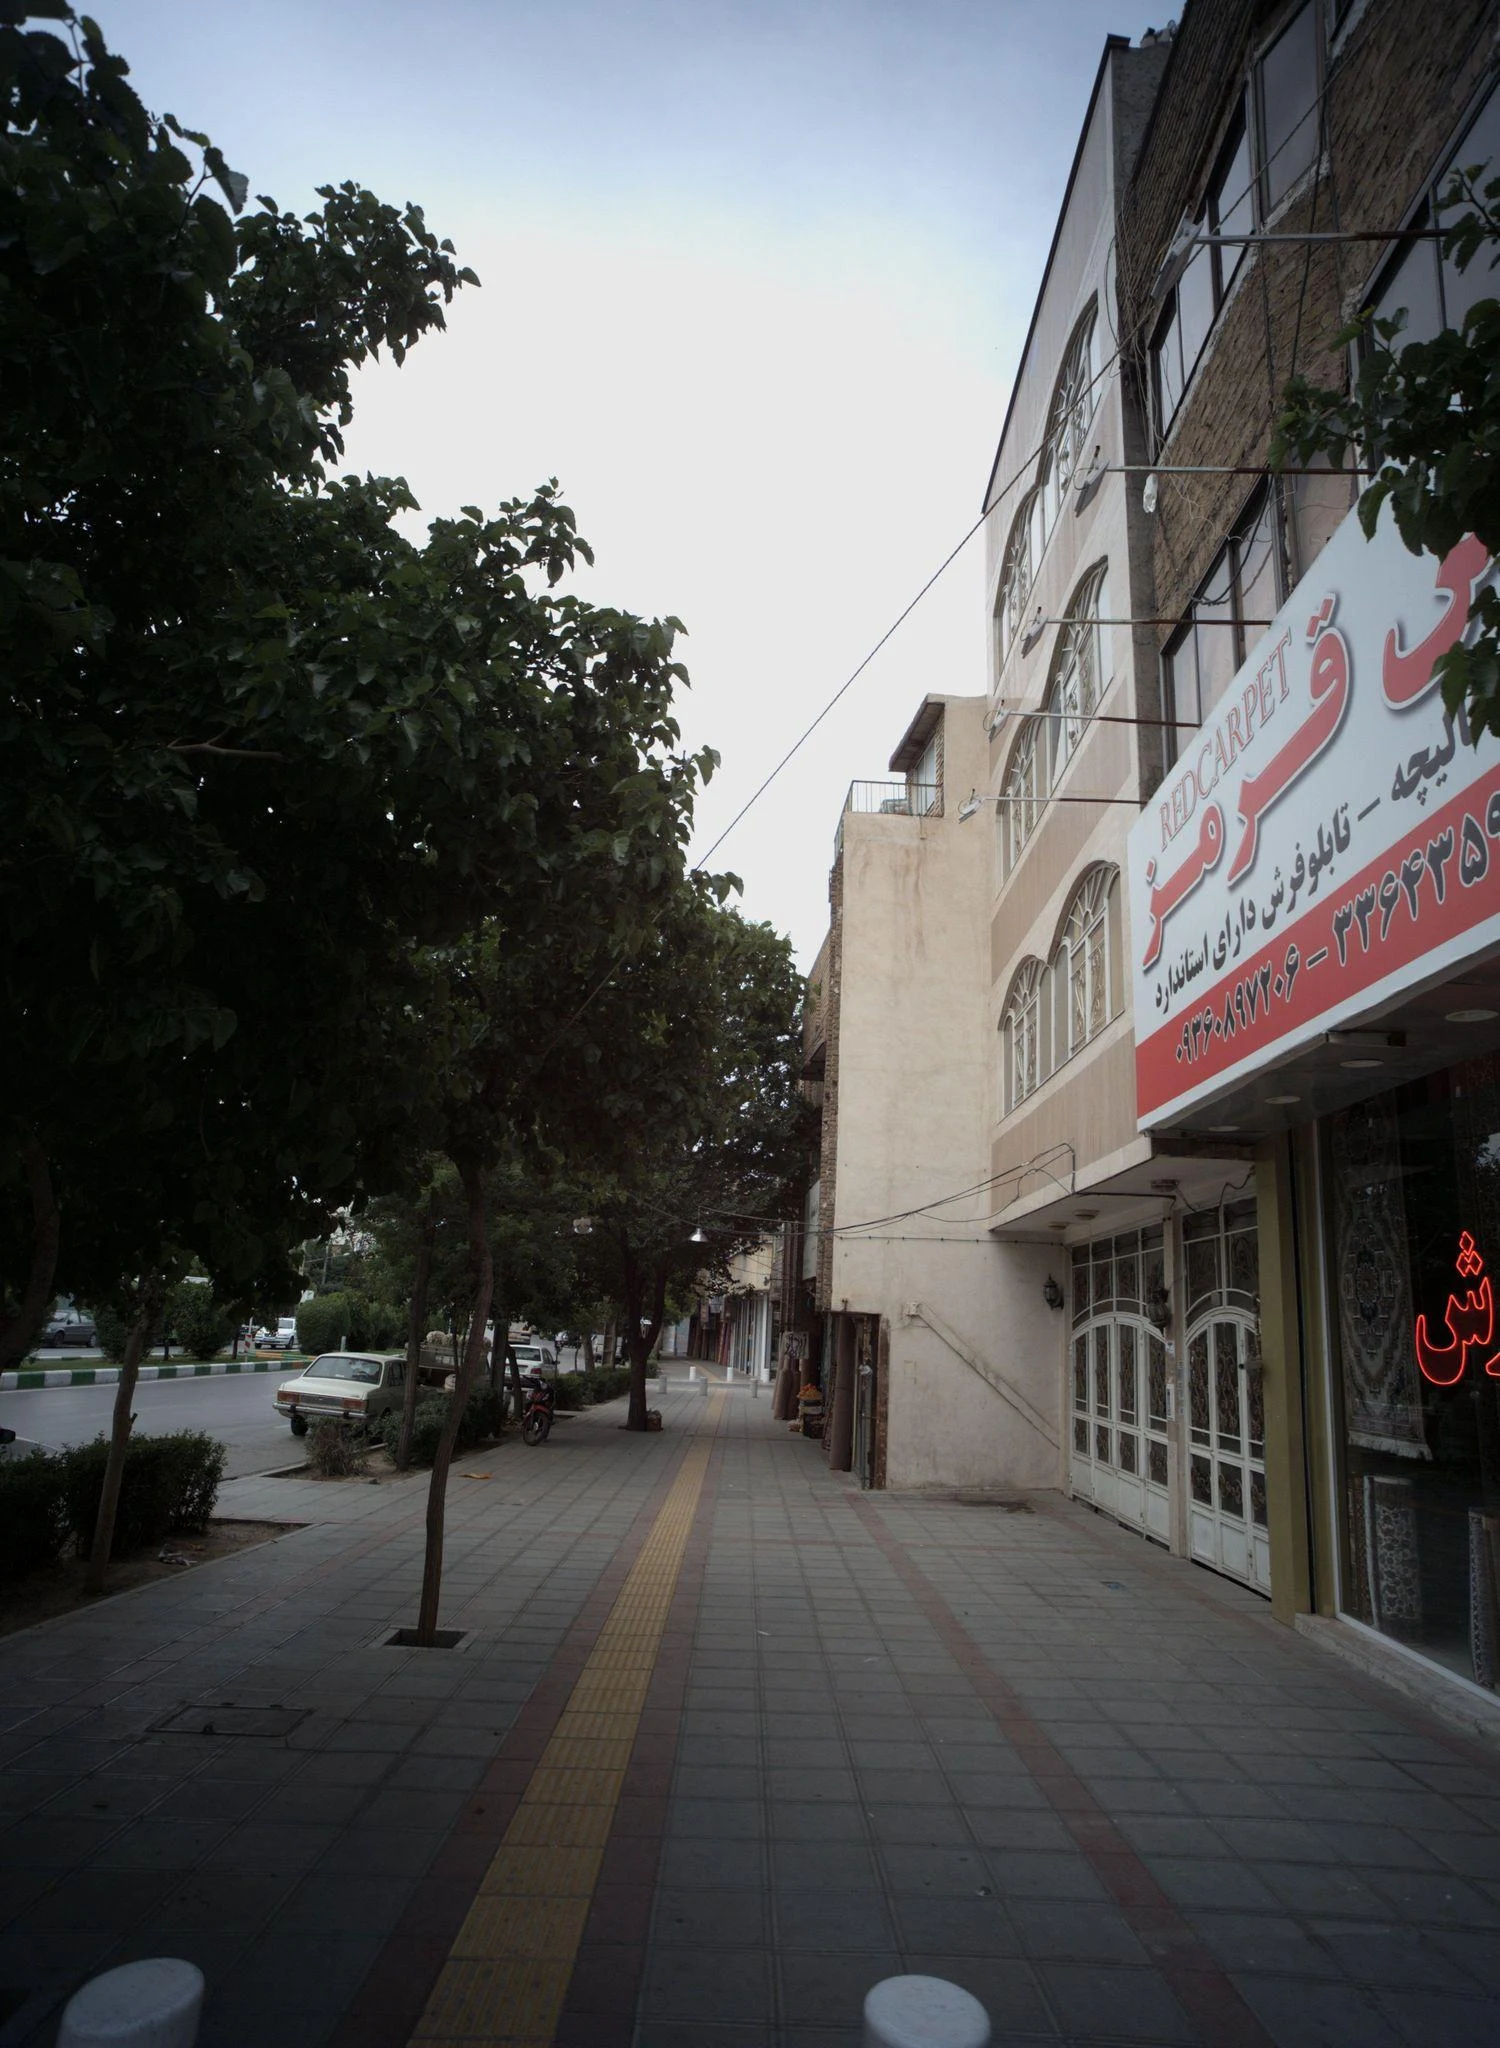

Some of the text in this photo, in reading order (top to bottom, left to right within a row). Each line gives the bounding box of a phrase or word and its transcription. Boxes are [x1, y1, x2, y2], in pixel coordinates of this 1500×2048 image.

[1143, 592, 1350, 973] قرمز
[1155, 931, 1208, 1014] استاندارد
[1213, 896, 1256, 970] دارای
